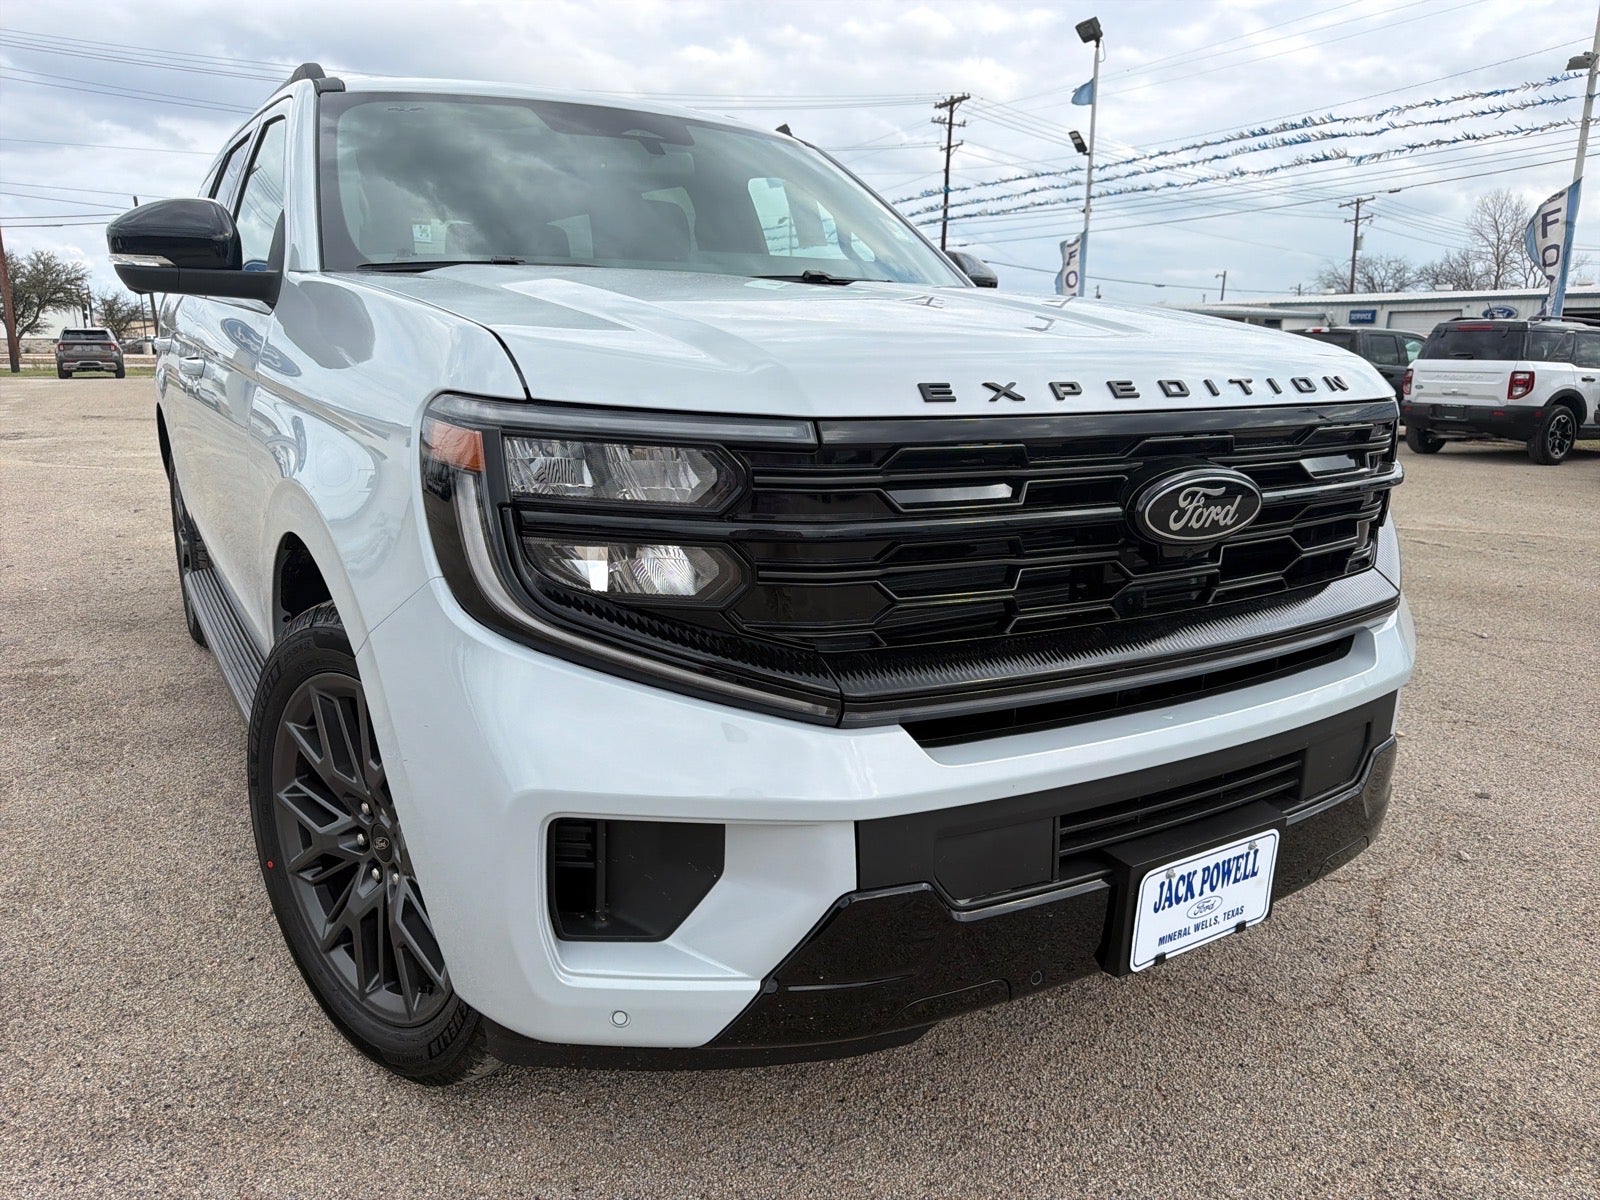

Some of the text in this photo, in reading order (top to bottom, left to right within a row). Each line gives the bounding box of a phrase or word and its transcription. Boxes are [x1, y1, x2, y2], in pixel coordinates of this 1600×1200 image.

[1541, 207, 1562, 281] FO
[1065, 249, 1079, 296] FO
[917, 375, 1350, 403] EXPEDITION
[1169, 486, 1240, 531] Ford
[1153, 848, 1260, 913] JACK POWELL
[1158, 905, 1245, 947] MINERAL WELLS, TEXAS
[1193, 899, 1217, 916] Ford
